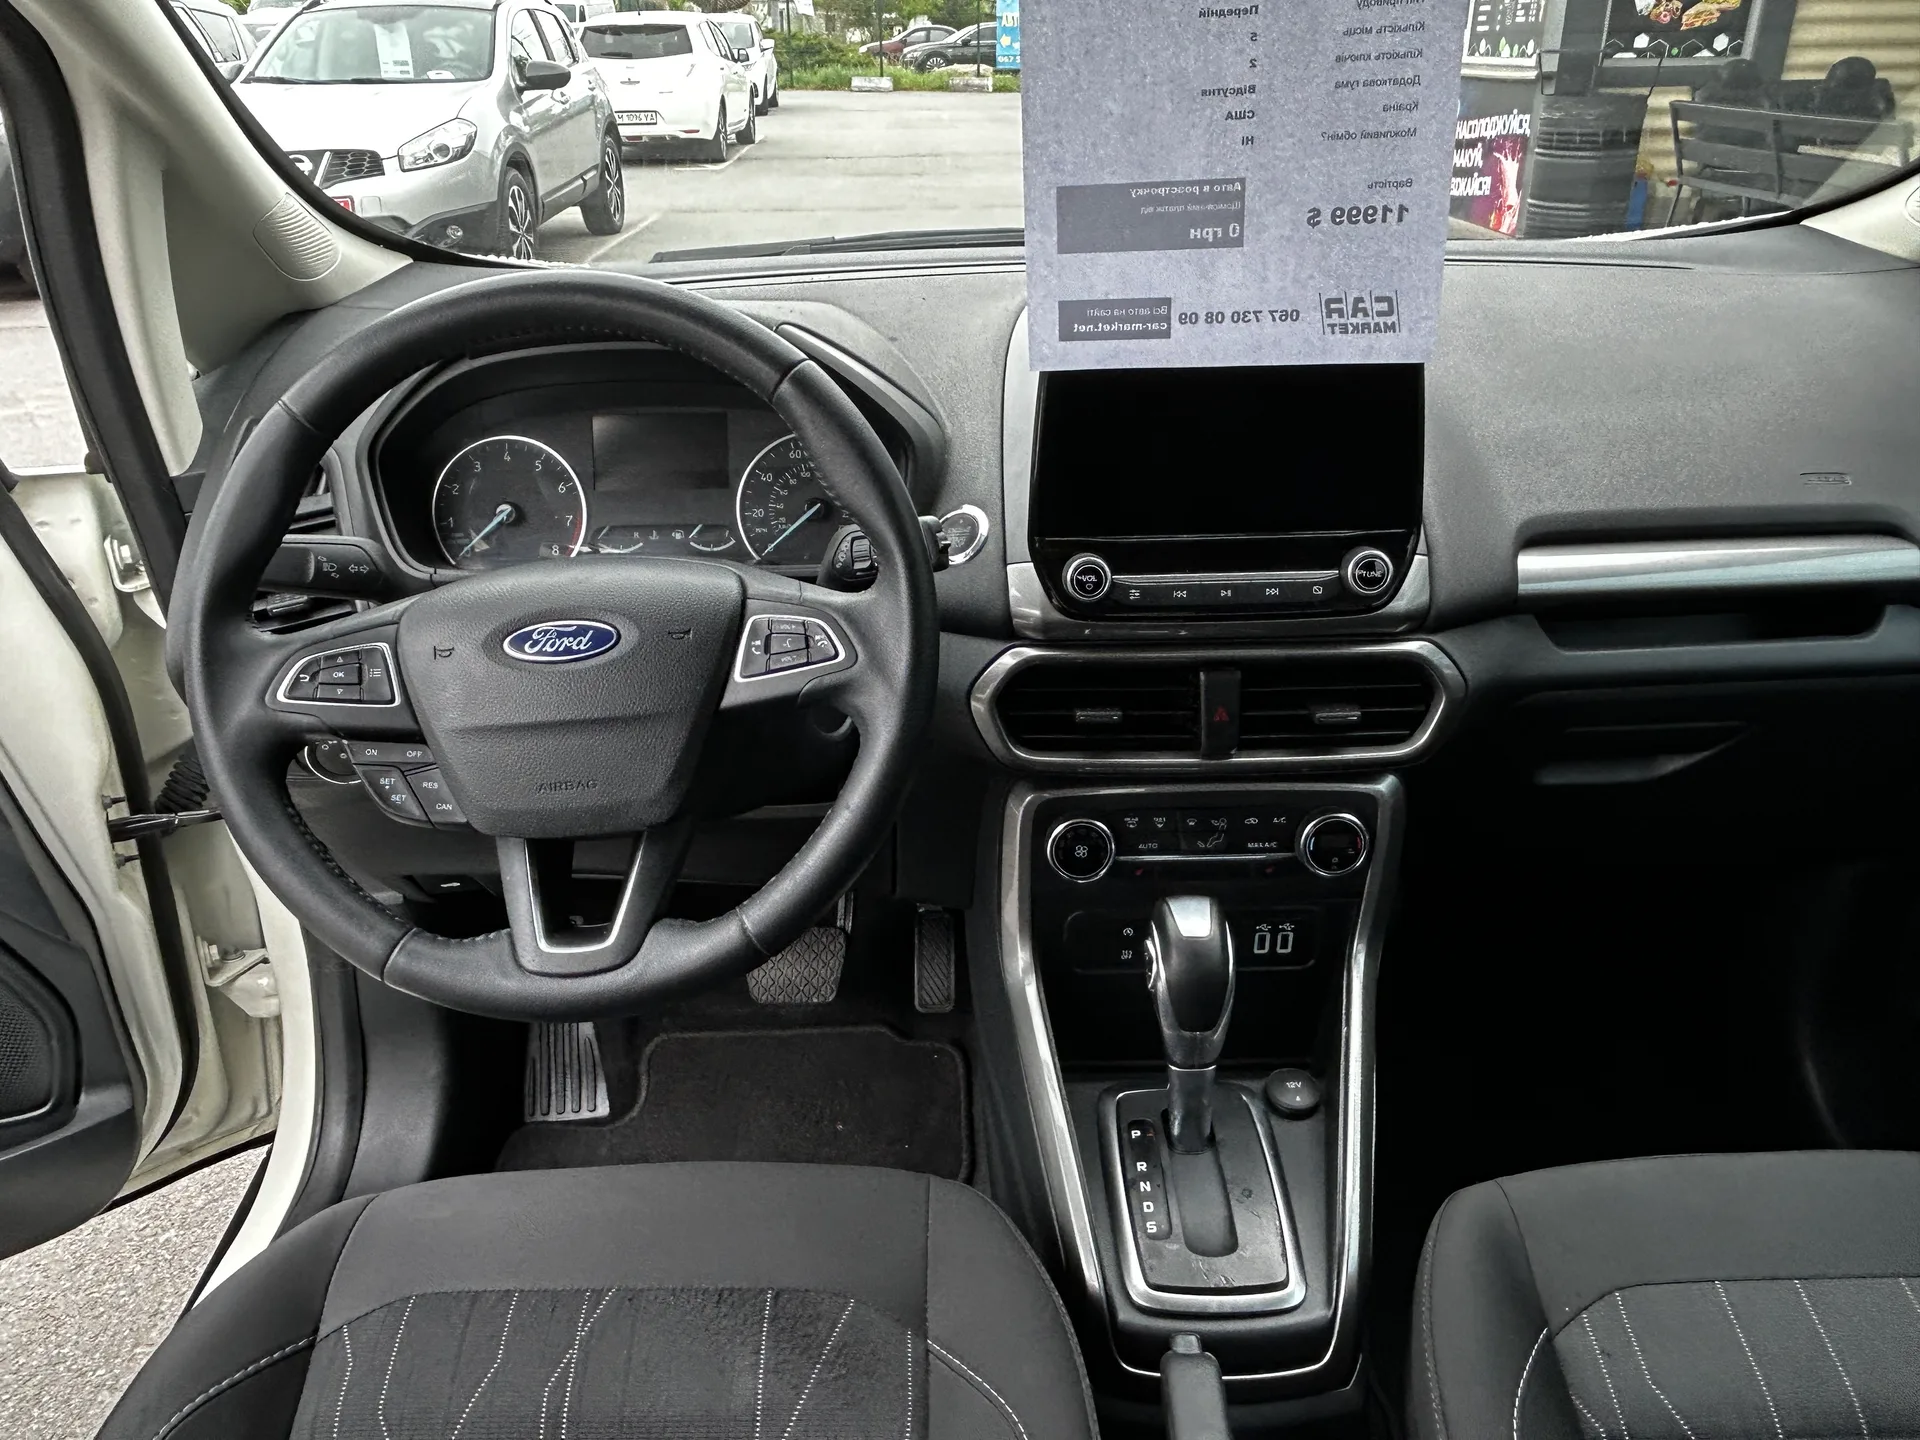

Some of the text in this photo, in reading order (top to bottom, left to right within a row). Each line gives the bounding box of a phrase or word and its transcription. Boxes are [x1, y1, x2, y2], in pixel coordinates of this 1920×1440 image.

[503, 451, 511, 462] 4
[789, 449, 802, 459] 60
[474, 461, 482, 472] 3
[535, 461, 542, 471] 5
[761, 473, 773, 482] 40
[452, 484, 460, 495] 2
[558, 482, 566, 494] 6
[752, 509, 764, 518] 20
[448, 517, 454, 527] 1
[565, 515, 573, 527] 7
[551, 545, 559, 556] 8
[524, 626, 593, 653] Ford
[538, 780, 598, 793] AIRBAG
[390, 794, 407, 802] SET
[1285, 1081, 1302, 1089] 12V
[1131, 1130, 1141, 1139] P
[1136, 1162, 1147, 1172] R
[1140, 1181, 1151, 1192] N
[1143, 1201, 1154, 1212] D
[1146, 1221, 1157, 1233] S
